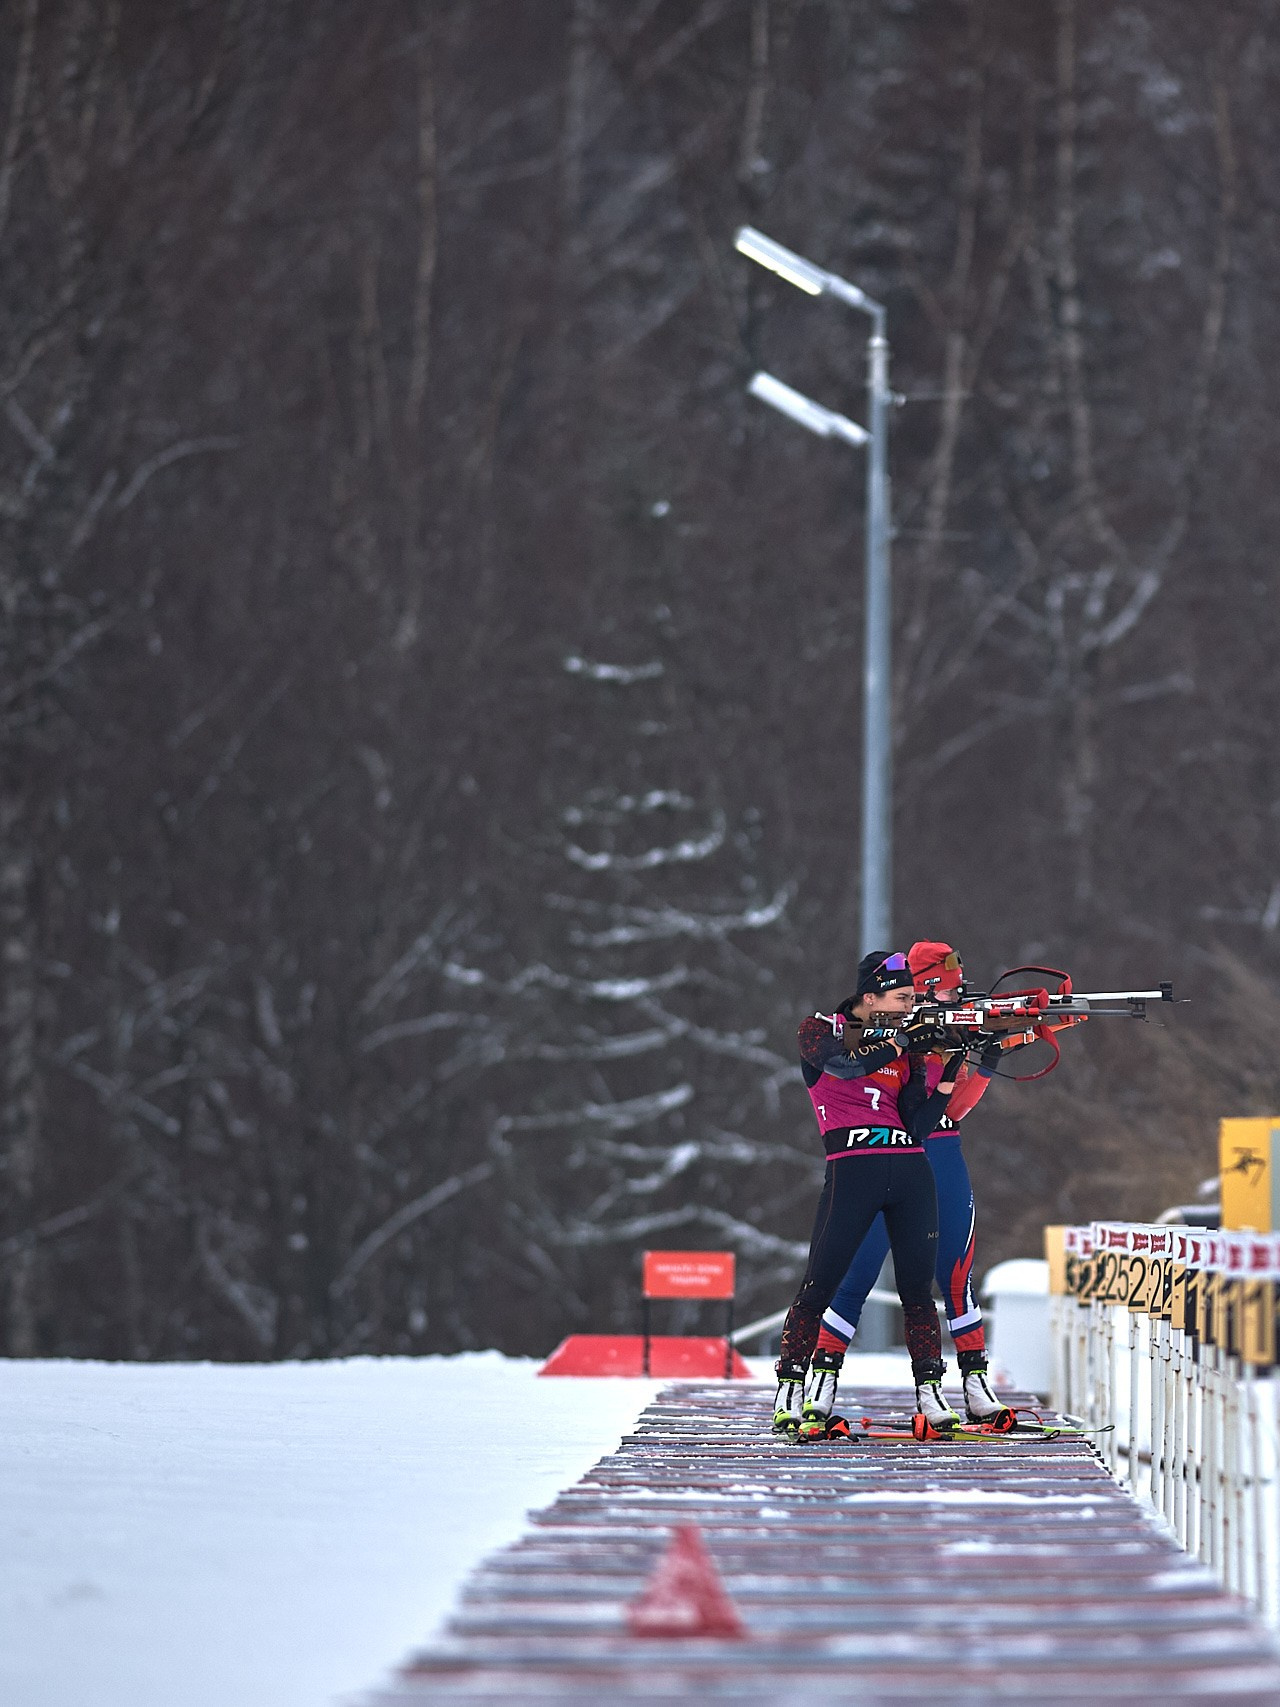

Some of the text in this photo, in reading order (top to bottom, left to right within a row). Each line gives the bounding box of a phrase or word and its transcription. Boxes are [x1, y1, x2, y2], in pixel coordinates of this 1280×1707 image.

[863, 1028, 898, 1038] PARI
[863, 1086, 881, 1111] 7
[846, 1127, 913, 1148] PARI
[1106, 1252, 1129, 1302] 25
[1129, 1256, 1147, 1307] 2
[1150, 1259, 1162, 1312] 2
